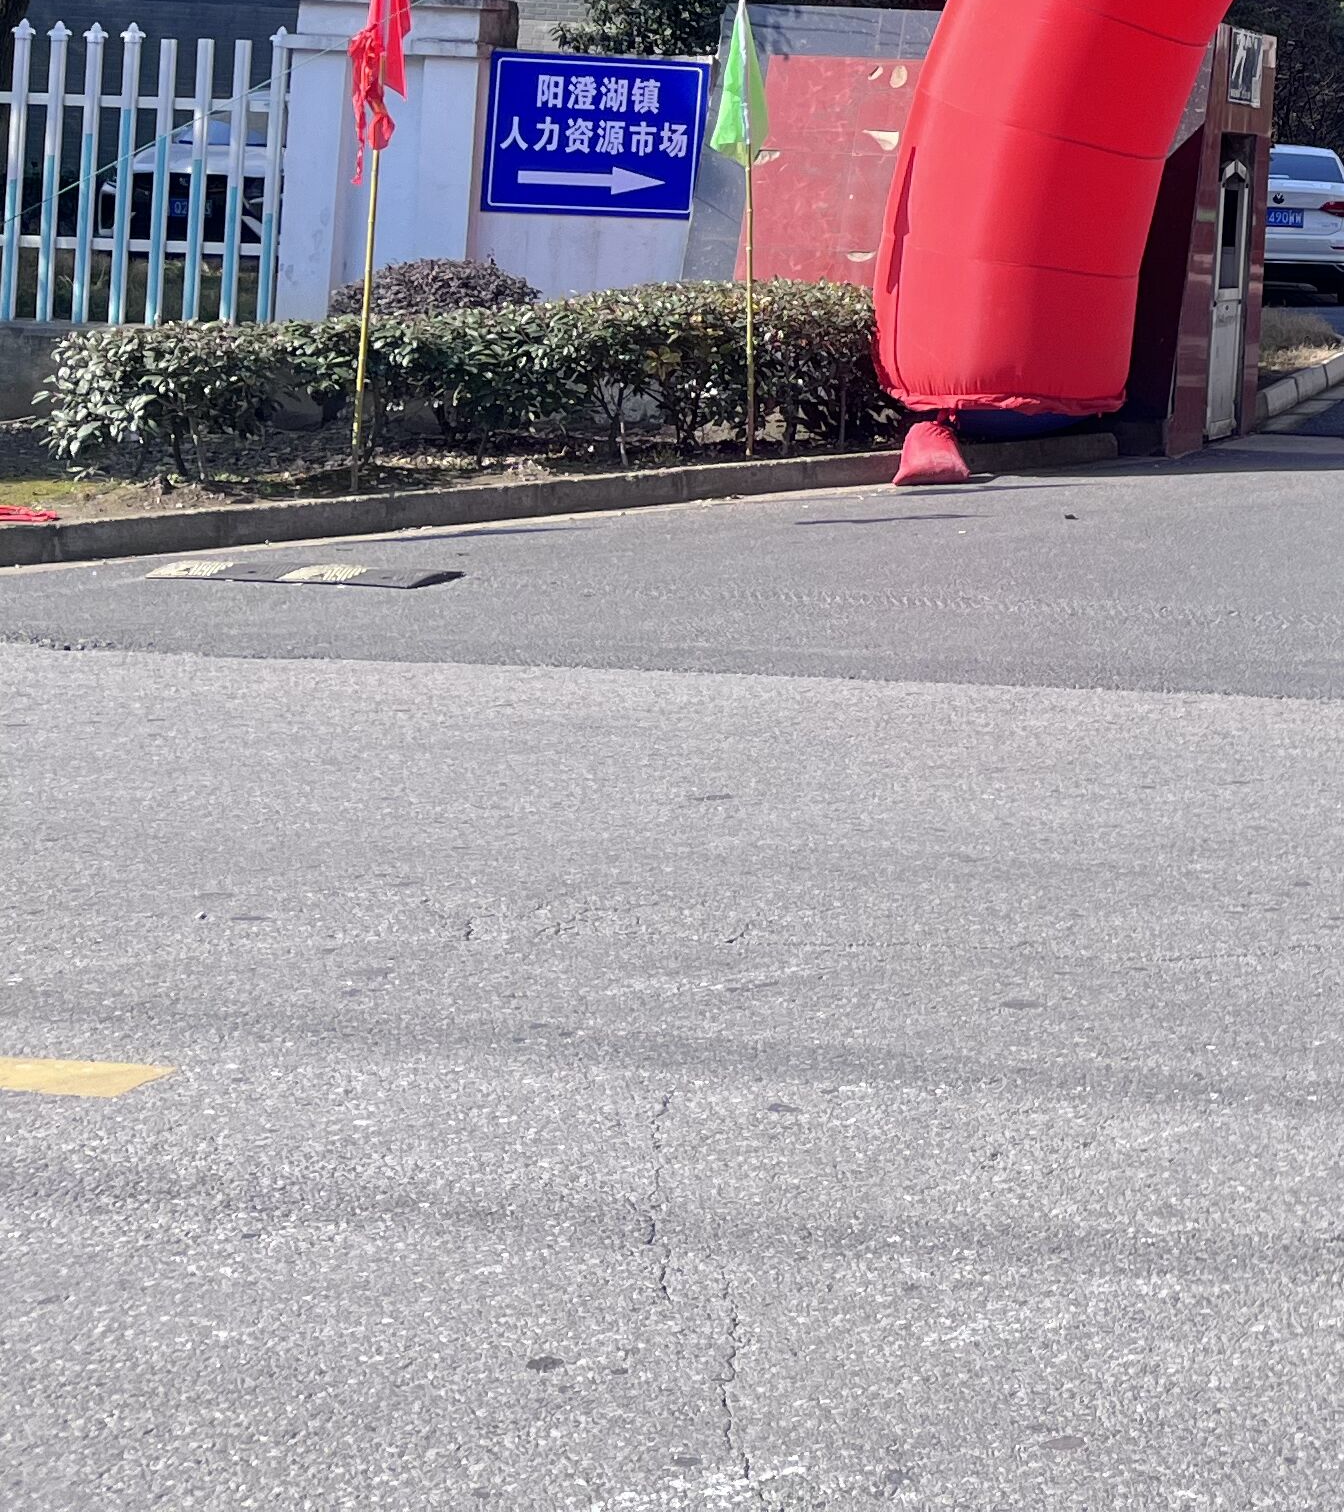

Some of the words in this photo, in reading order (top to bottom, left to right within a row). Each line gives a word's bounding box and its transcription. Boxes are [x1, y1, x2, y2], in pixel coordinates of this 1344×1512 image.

[536, 74, 661, 115] 阳澄湖镇
[500, 116, 688, 158] 人力资源市场
